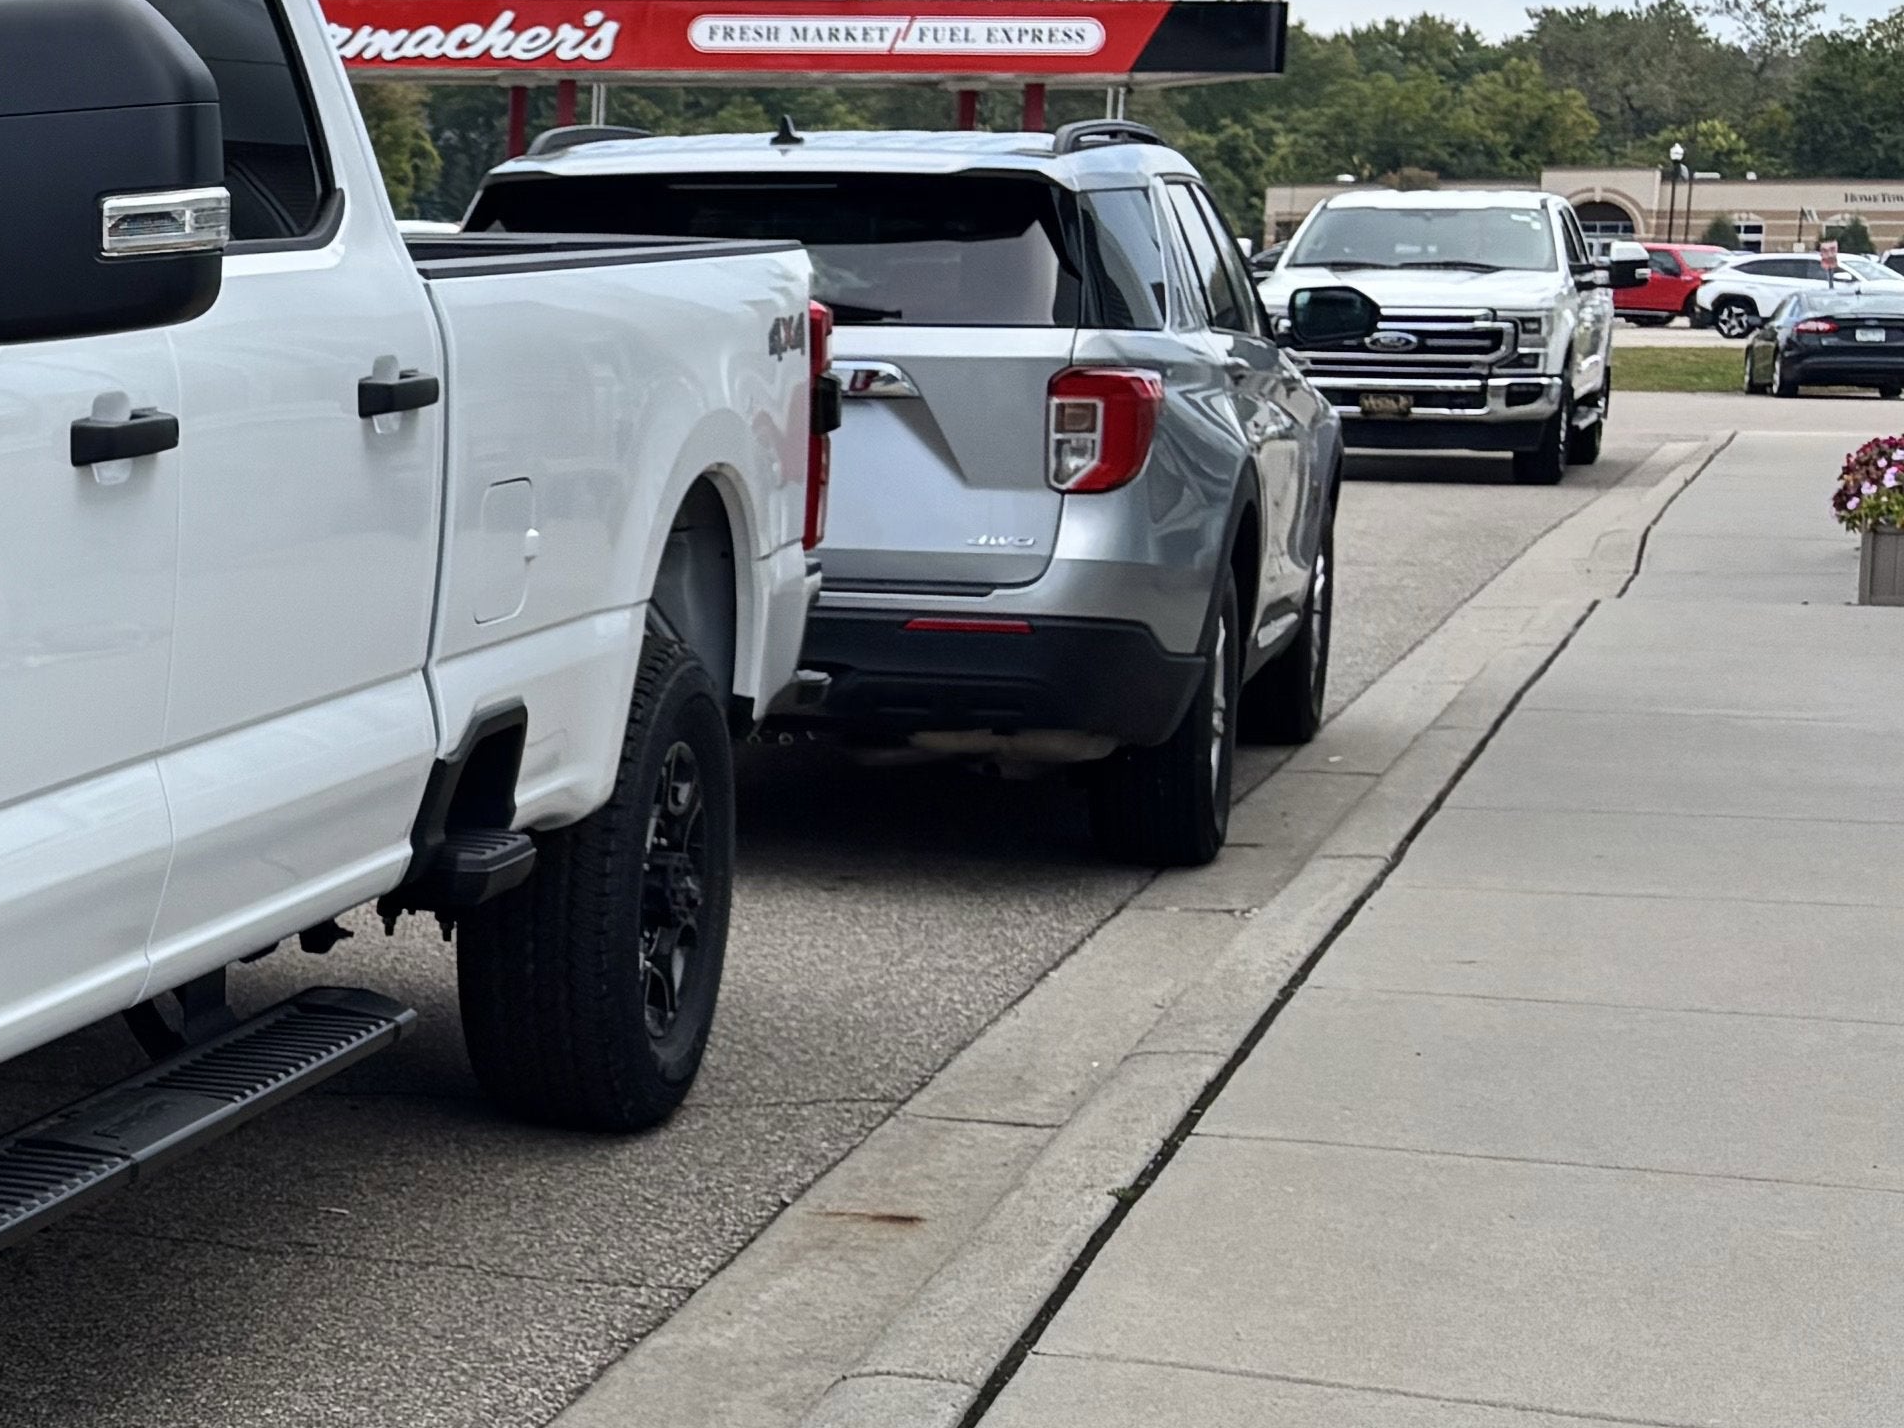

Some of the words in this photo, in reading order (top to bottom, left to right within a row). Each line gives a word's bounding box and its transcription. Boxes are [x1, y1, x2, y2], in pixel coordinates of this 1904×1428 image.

[708, 25, 780, 42] FRESH
[791, 25, 890, 43] MARKET
[918, 27, 977, 44] FUEL
[987, 28, 1086, 44] EXPRESS
